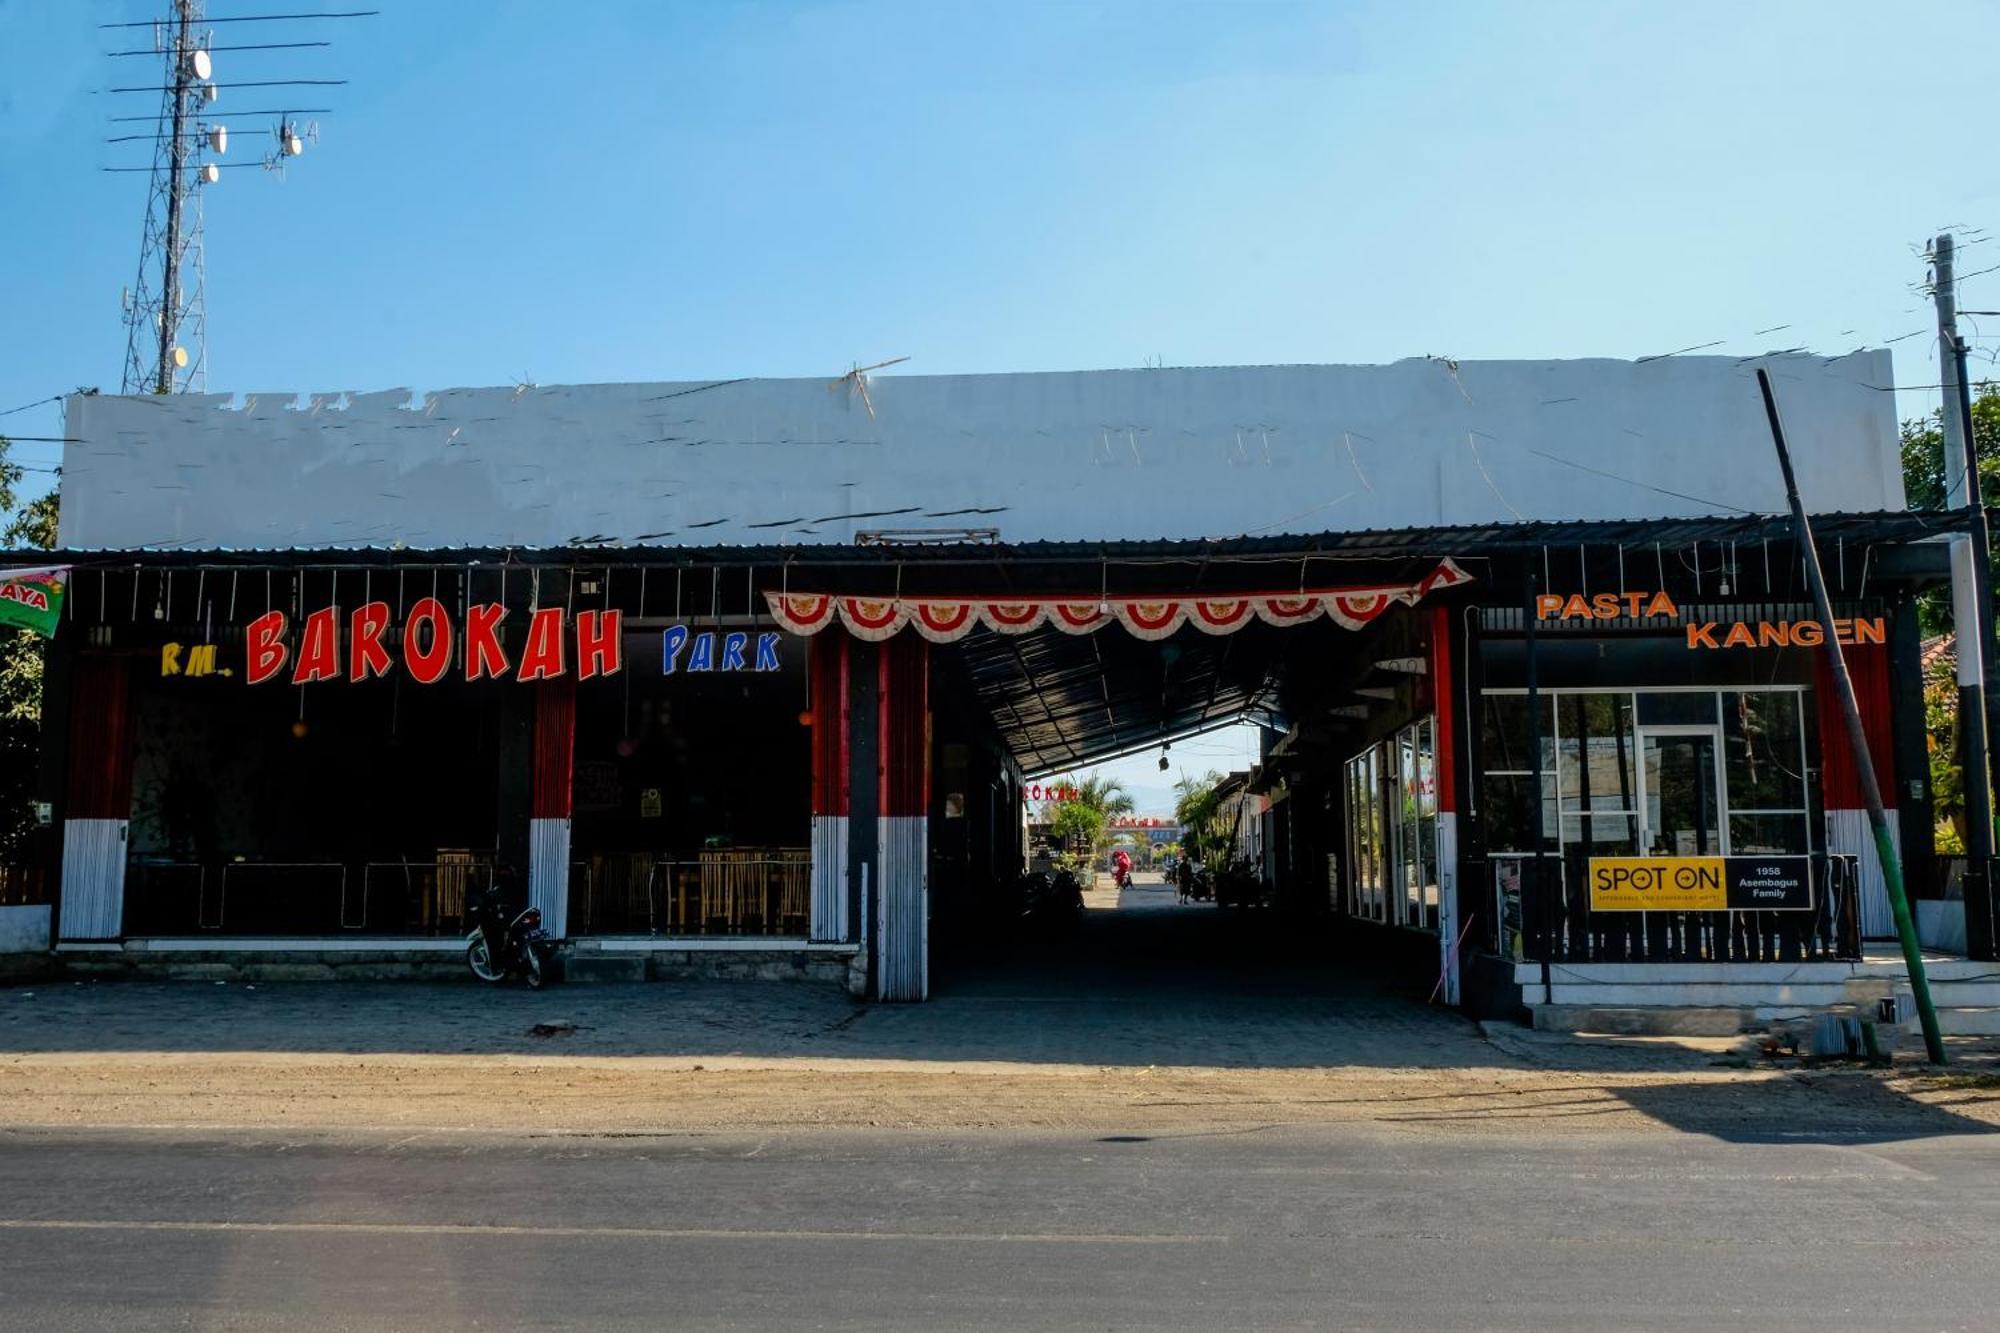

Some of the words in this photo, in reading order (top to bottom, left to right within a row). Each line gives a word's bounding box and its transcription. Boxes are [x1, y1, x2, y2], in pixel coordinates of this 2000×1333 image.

[1536, 591, 1678, 620] PASTA
[246, 597, 624, 685] BAROKAH
[663, 624, 782, 675] PARK
[1687, 617, 1886, 649] KANGEN
[1597, 867, 1667, 891] SPOT
[1674, 867, 1720, 890] ON
[1739, 878, 1799, 889] Asembagus
[1756, 867, 1781, 876] 1958
[1752, 888, 1787, 899] Family
